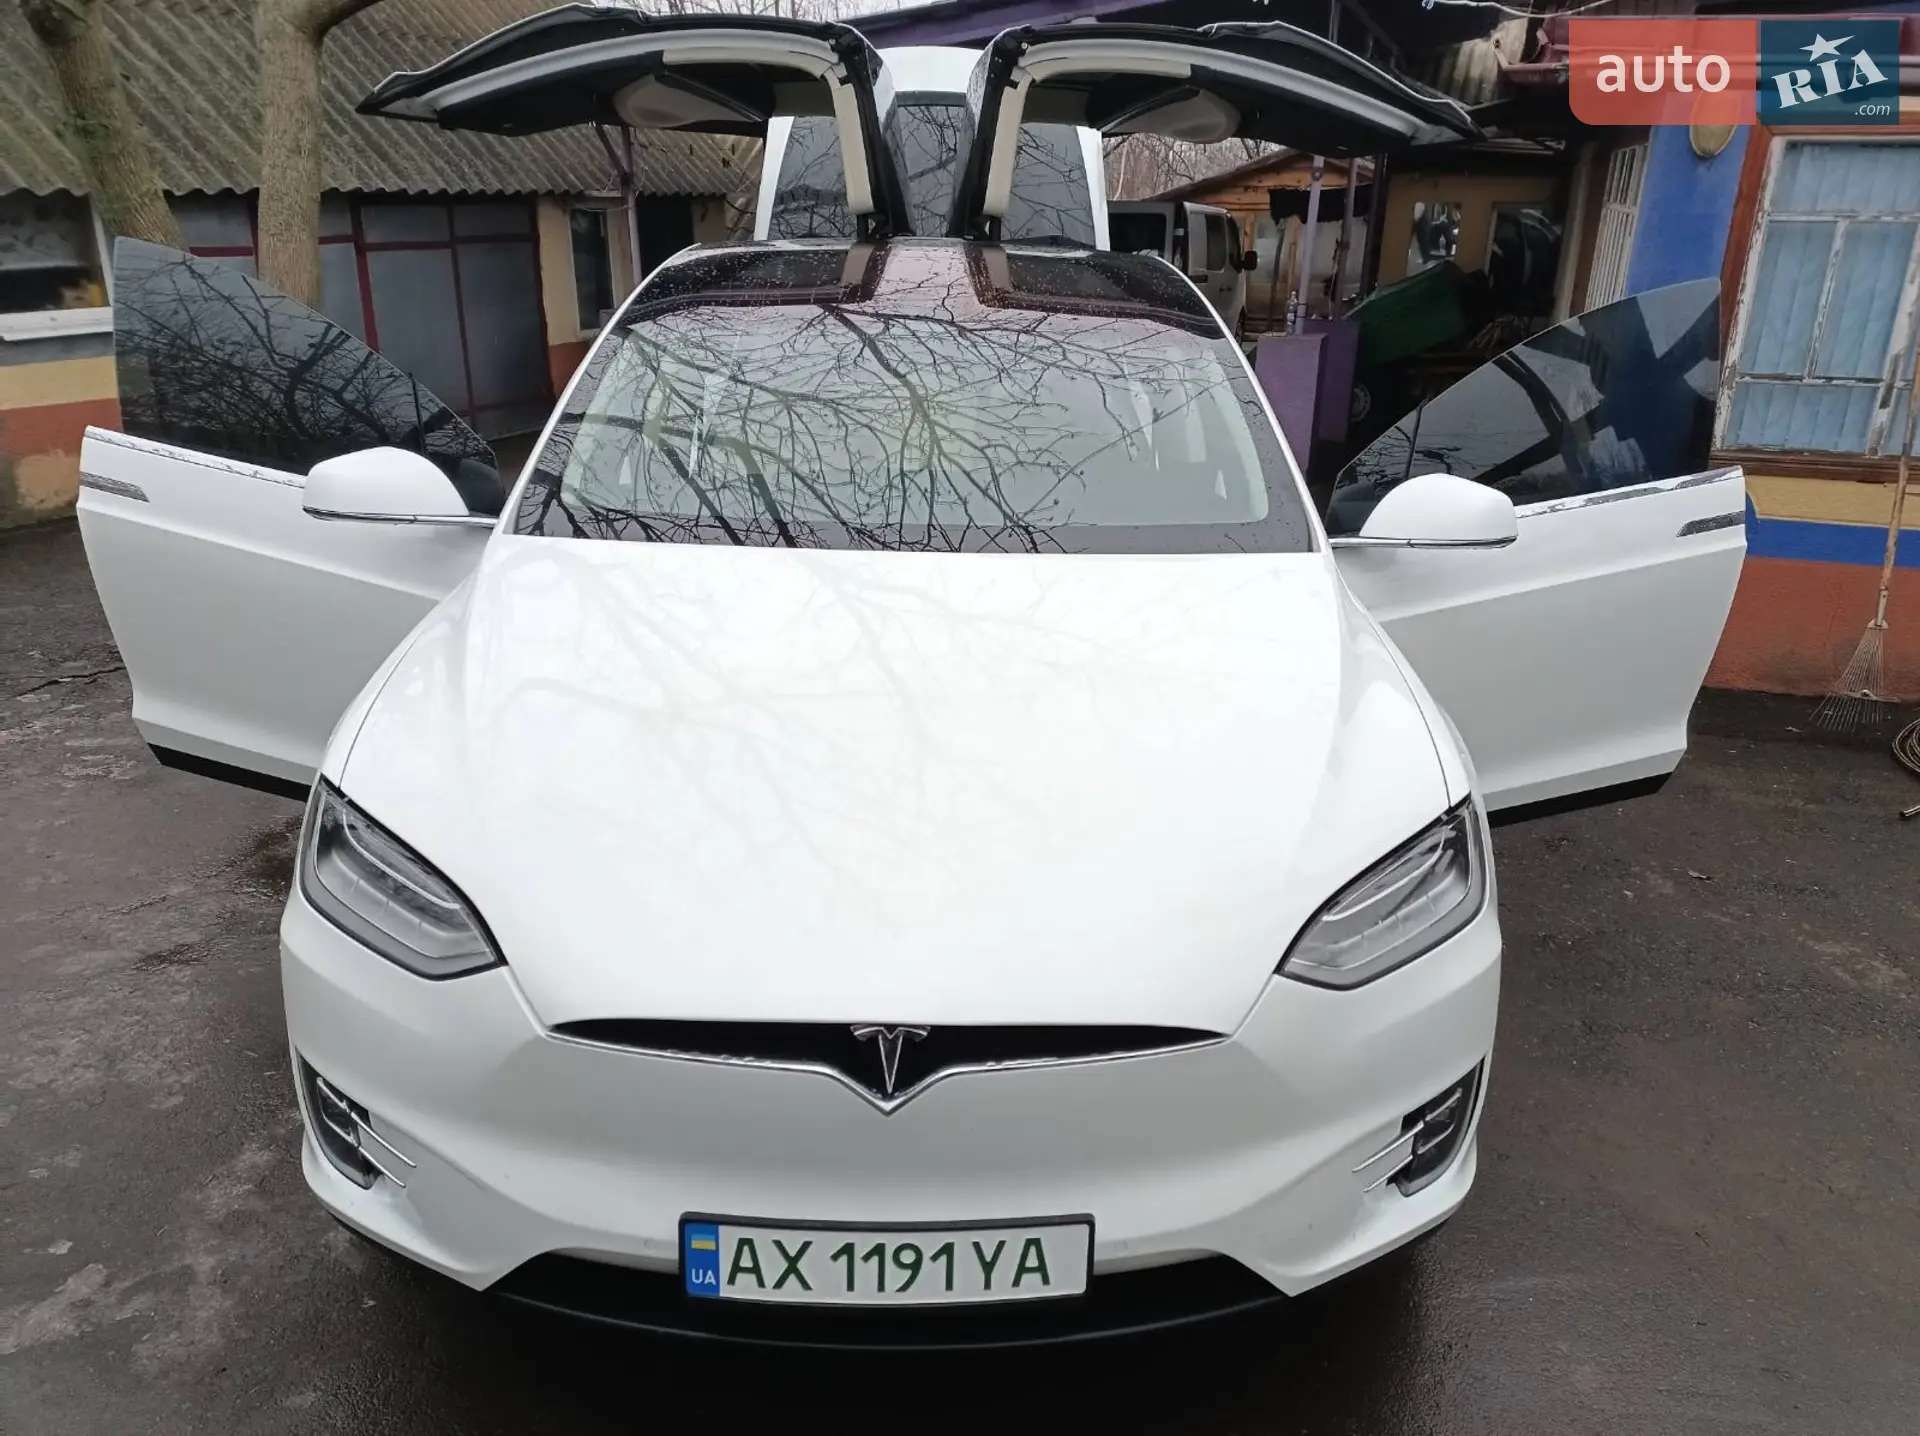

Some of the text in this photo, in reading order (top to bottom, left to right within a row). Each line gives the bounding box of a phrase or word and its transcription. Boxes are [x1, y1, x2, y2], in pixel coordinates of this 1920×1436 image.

[691, 1267, 717, 1286] UA
[726, 1237, 1051, 1293] AX 1191 YA
